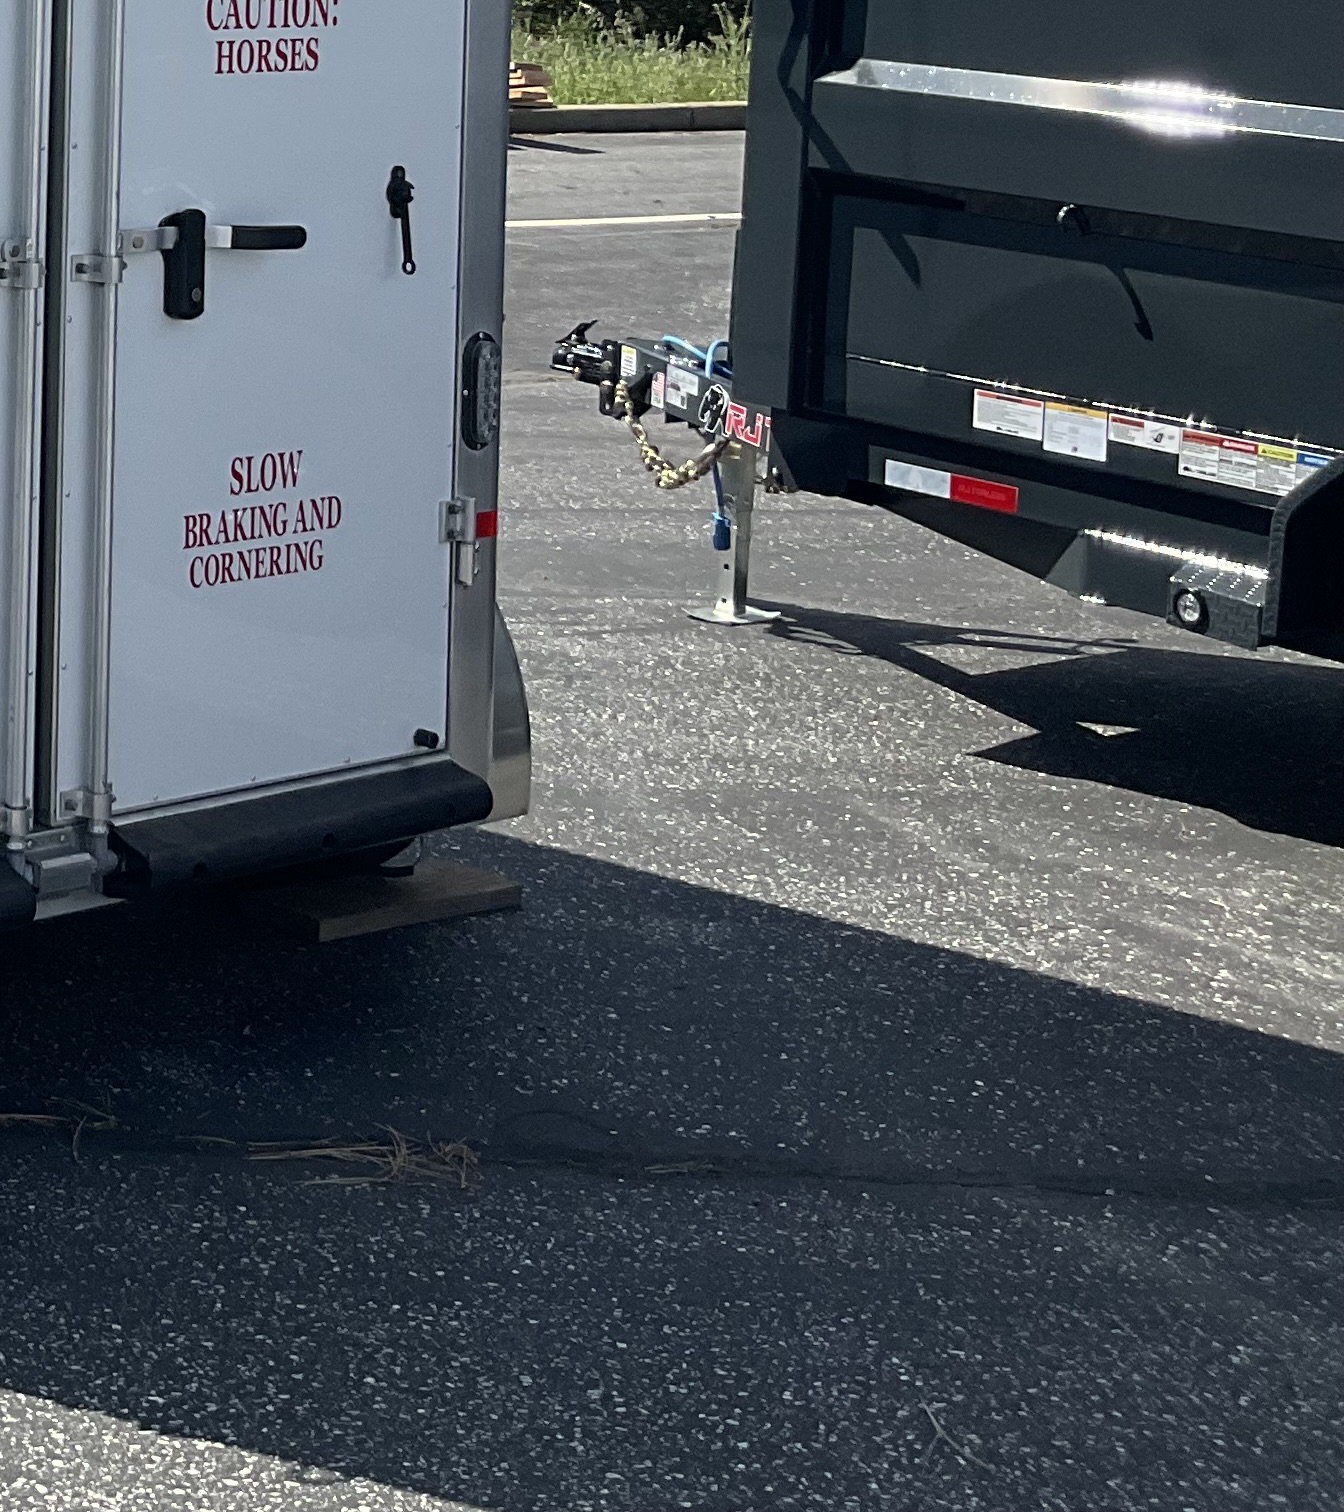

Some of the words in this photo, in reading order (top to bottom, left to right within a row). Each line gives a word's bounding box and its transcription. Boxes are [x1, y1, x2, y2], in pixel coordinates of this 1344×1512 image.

[214, 37, 320, 74] HORSES
[229, 449, 304, 496] SLOW
[182, 501, 289, 550] BRAKING
[292, 495, 342, 534] AND
[189, 539, 324, 589] CORNERING
